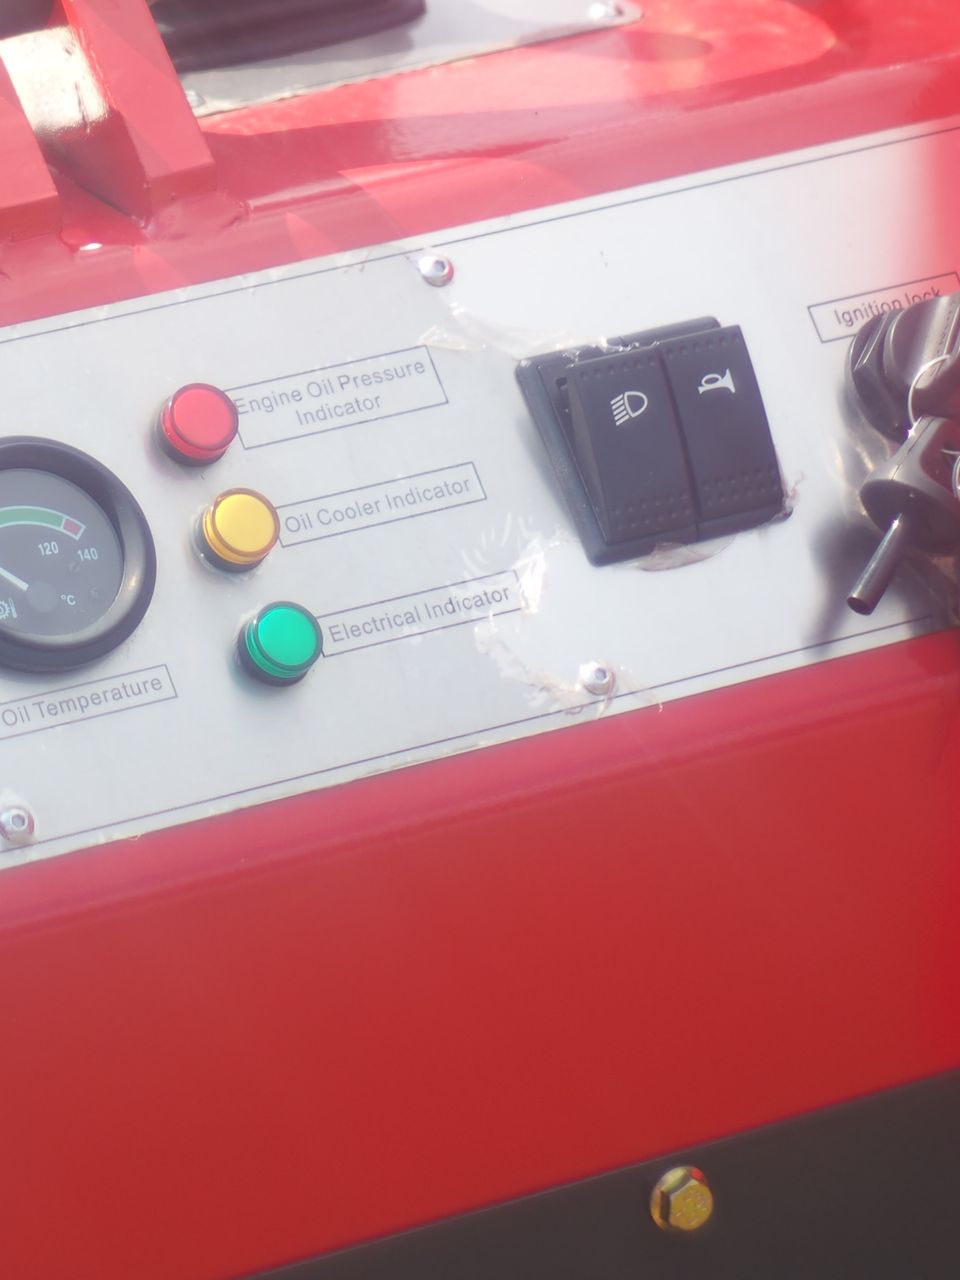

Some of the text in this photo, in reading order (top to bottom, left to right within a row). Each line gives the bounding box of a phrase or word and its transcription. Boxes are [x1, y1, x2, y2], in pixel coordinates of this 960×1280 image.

[834, 298, 903, 327] Ignition
[235, 360, 427, 415] Engine Oil Pressure
[296, 394, 383, 426] Indicator
[284, 477, 472, 533] Oil Cooler Indicator
[38, 541, 59, 557] 120
[77, 547, 99, 562] 140
[328, 586, 511, 643] Electrical Indicator
[1, 676, 163, 727] Oil Temperature
